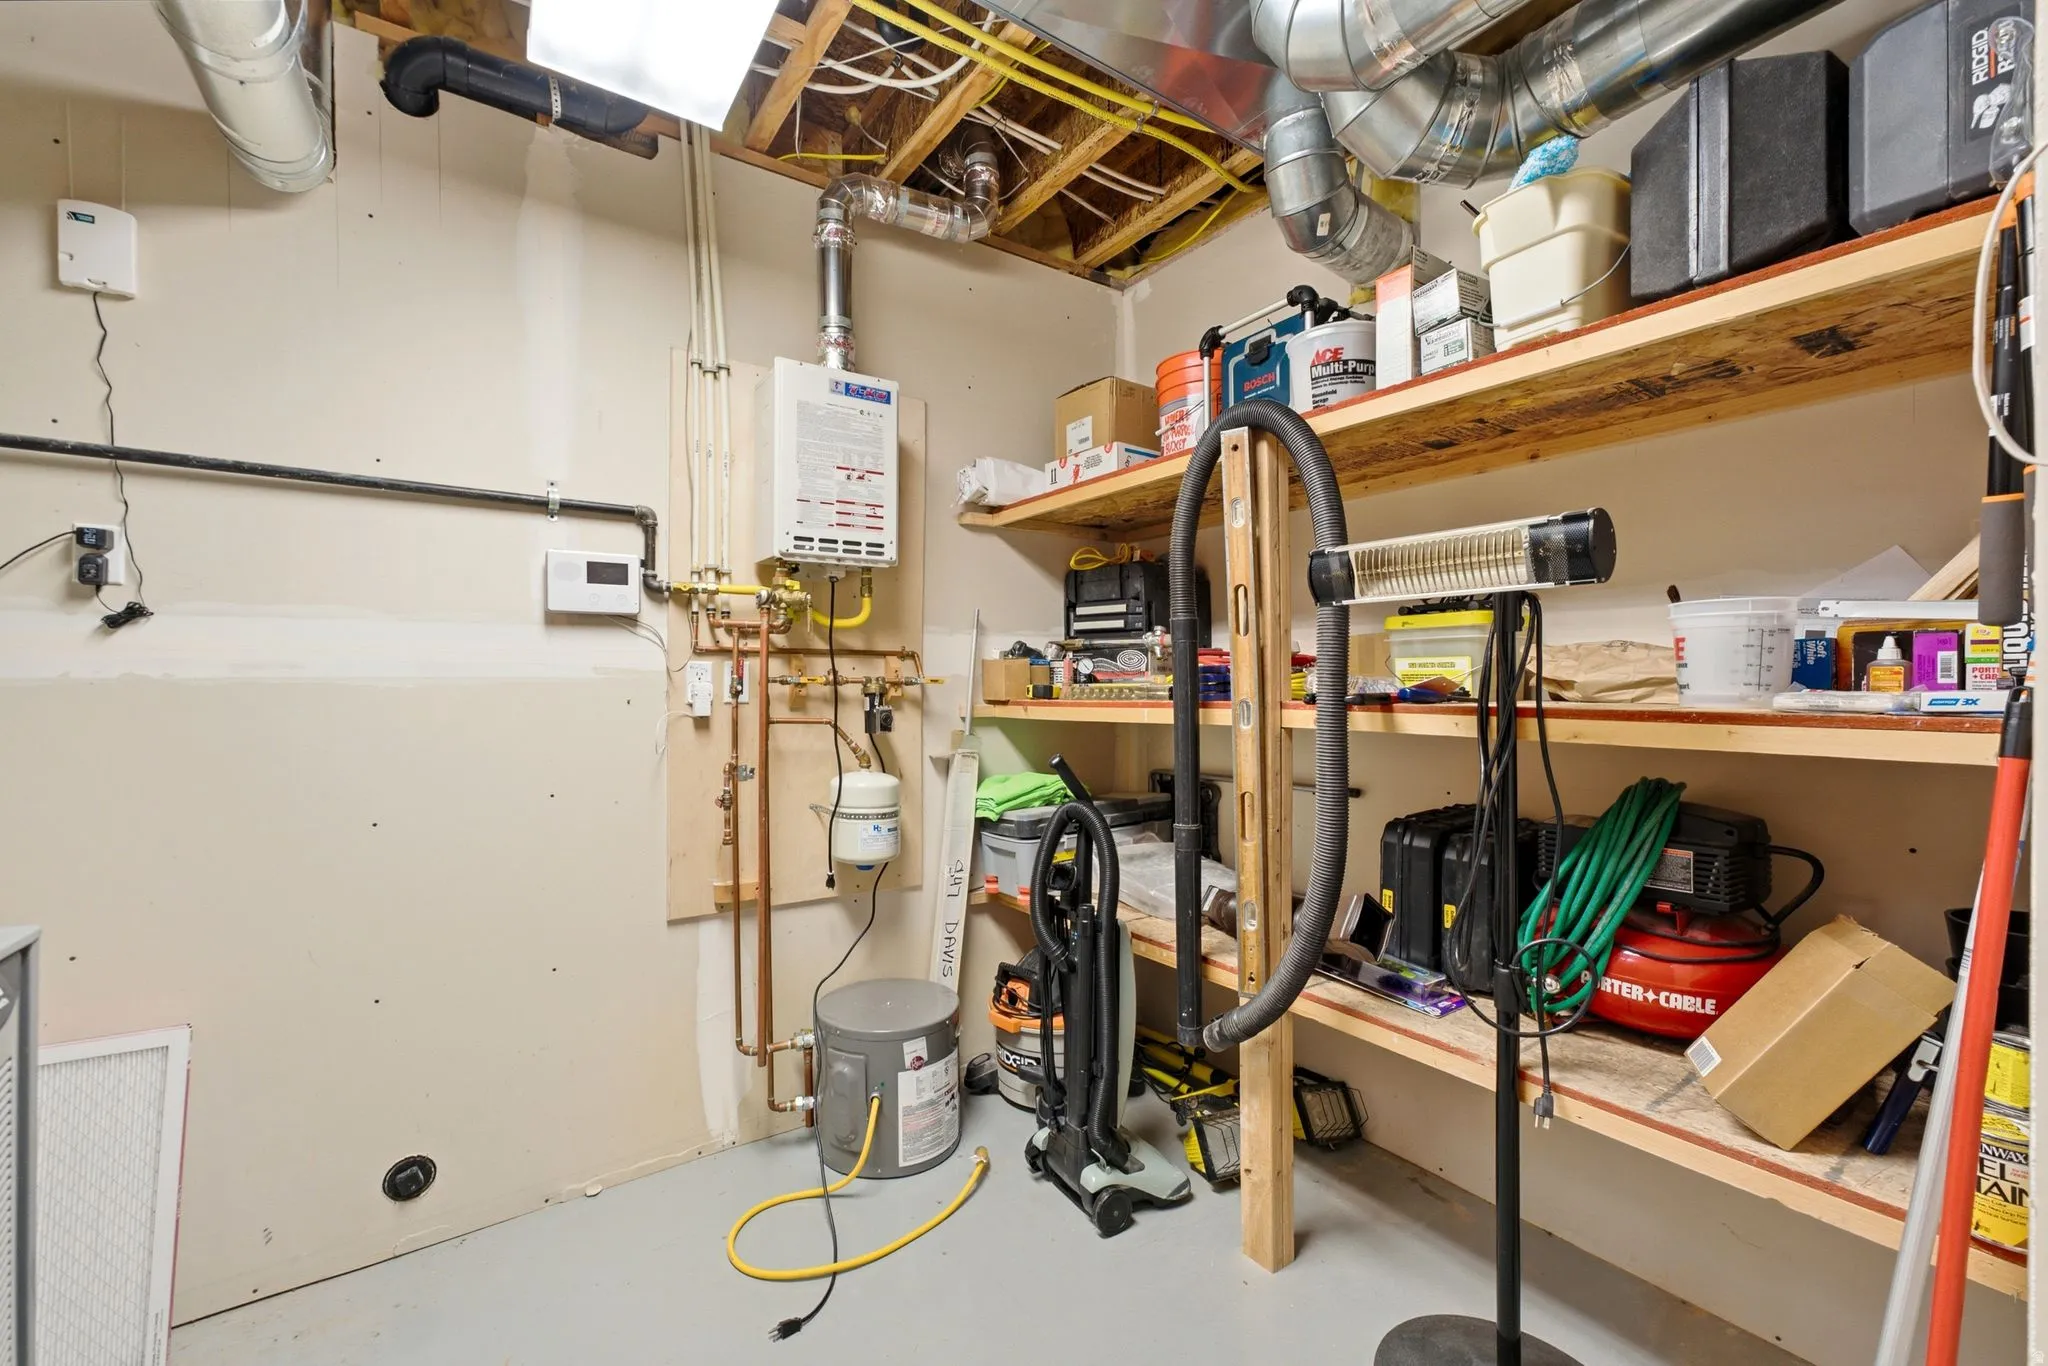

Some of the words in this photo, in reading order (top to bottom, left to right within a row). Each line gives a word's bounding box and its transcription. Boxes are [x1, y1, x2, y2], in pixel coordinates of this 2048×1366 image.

[1971, 29, 1989, 86] RIDGID
[1311, 347, 1345, 367] ACE
[1311, 360, 1377, 380] Multi-Purp
[1243, 372, 1277, 393] BOSCH
[1806, 640, 1816, 665] White
[1816, 640, 1827, 658] Soft
[1961, 698, 1981, 706] 3X
[942, 919, 960, 978] DAVIS
[1580, 970, 1644, 1002] PRTER
[1979, 1143, 2027, 1164] NWAX
[1978, 1156, 2020, 1185] EL
[1976, 1176, 2029, 1208] TAI
